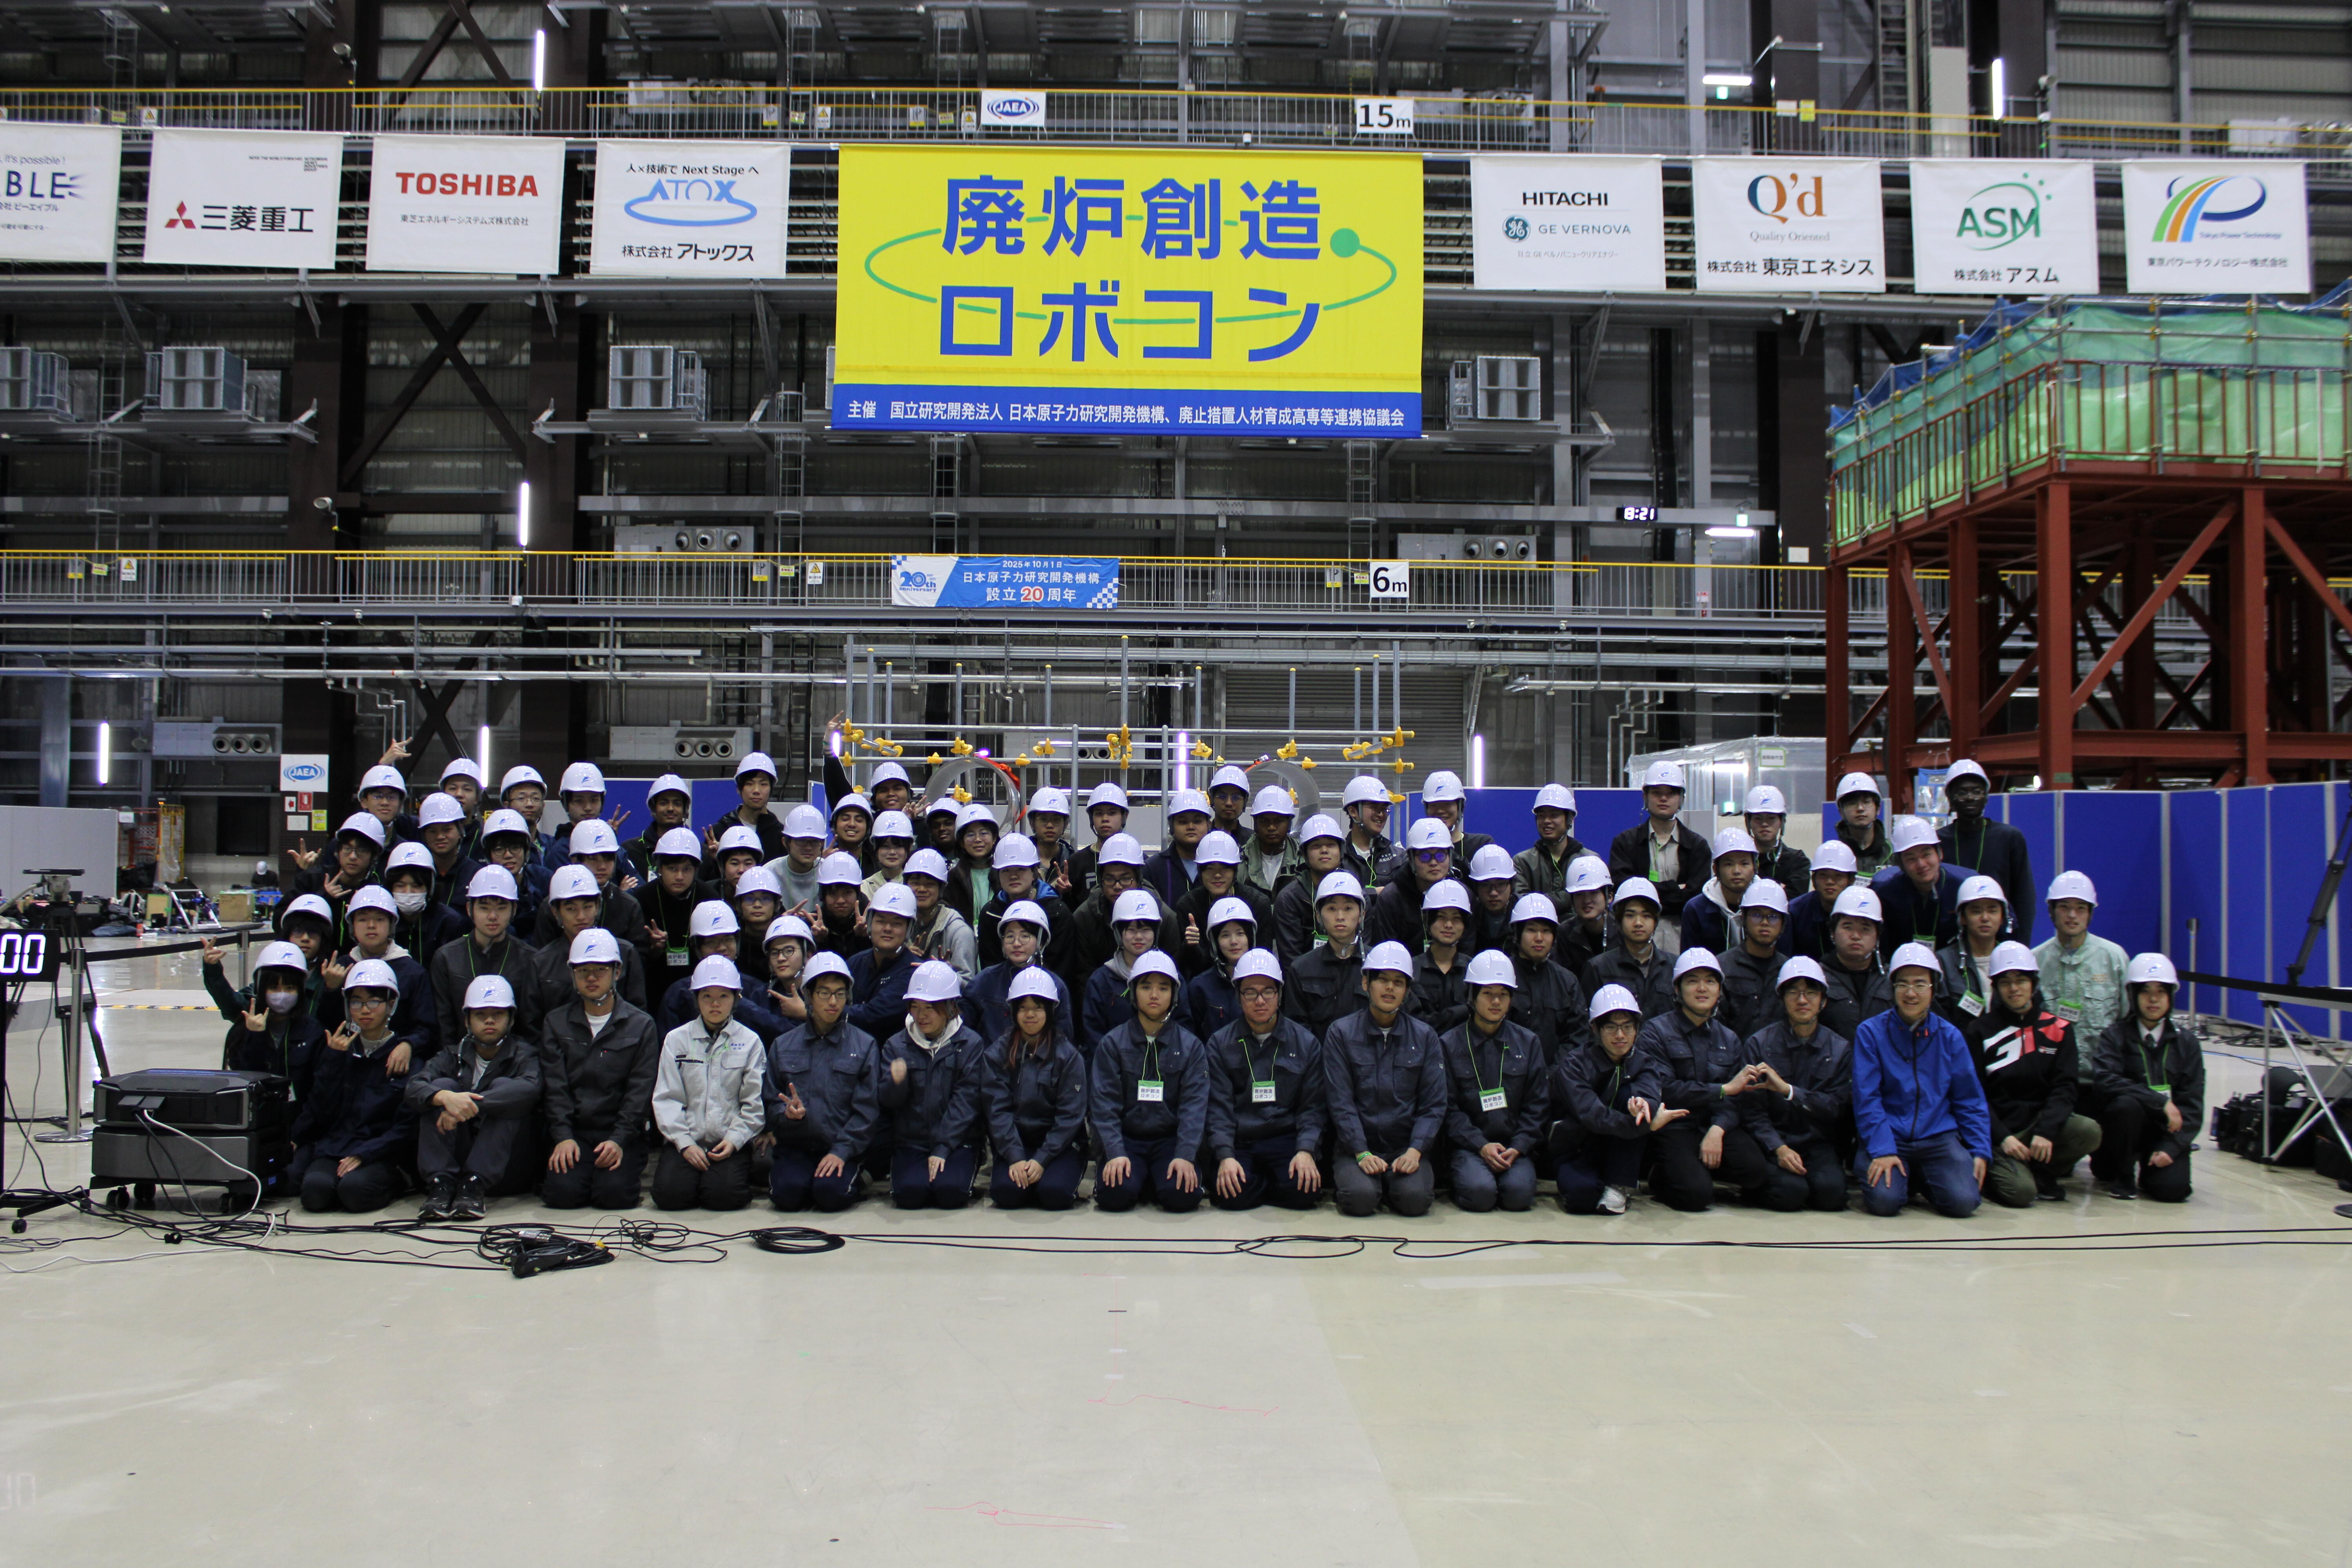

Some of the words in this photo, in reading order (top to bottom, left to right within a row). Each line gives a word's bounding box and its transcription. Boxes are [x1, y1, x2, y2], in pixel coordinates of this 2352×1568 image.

[996, 102, 1027, 113] JAEA
[1359, 104, 1410, 128] 15m
[682, 165, 709, 174] Next
[712, 165, 744, 176] Stage
[0, 170, 74, 199] BLE
[396, 172, 531, 197] TOSHIBA
[648, 178, 737, 203] ATOX
[1523, 192, 1608, 206] HITACHI
[201, 205, 314, 232] 三菱重工
[401, 214, 529, 226] 東芝エネルギーシステムズ株式会社
[942, 174, 1321, 260] 廃炉創造
[1956, 207, 2041, 238] ASM
[1539, 225, 1557, 234] GE
[1562, 225, 1631, 234] VERNOVA
[1750, 232, 1786, 243] Quality
[1788, 232, 1830, 241] Oriented
[621, 245, 673, 259] 株式会社
[677, 243, 754, 262] アトックス
[1708, 260, 1757, 273] 株式会社
[1762, 257, 1875, 276] 東京エネシス
[1954, 269, 2002, 281] 株式会社
[2006, 267, 2059, 283] アスム
[940, 279, 1320, 362] ロボコン
[848, 400, 876, 419] 主催
[890, 401, 1003, 421] 国立研究開発法人
[900, 571, 936, 588] 20th
[963, 572, 1100, 584] 日本原子力研究開発機構
[1373, 567, 1407, 592] 6m
[291, 768, 316, 777] JAEA
